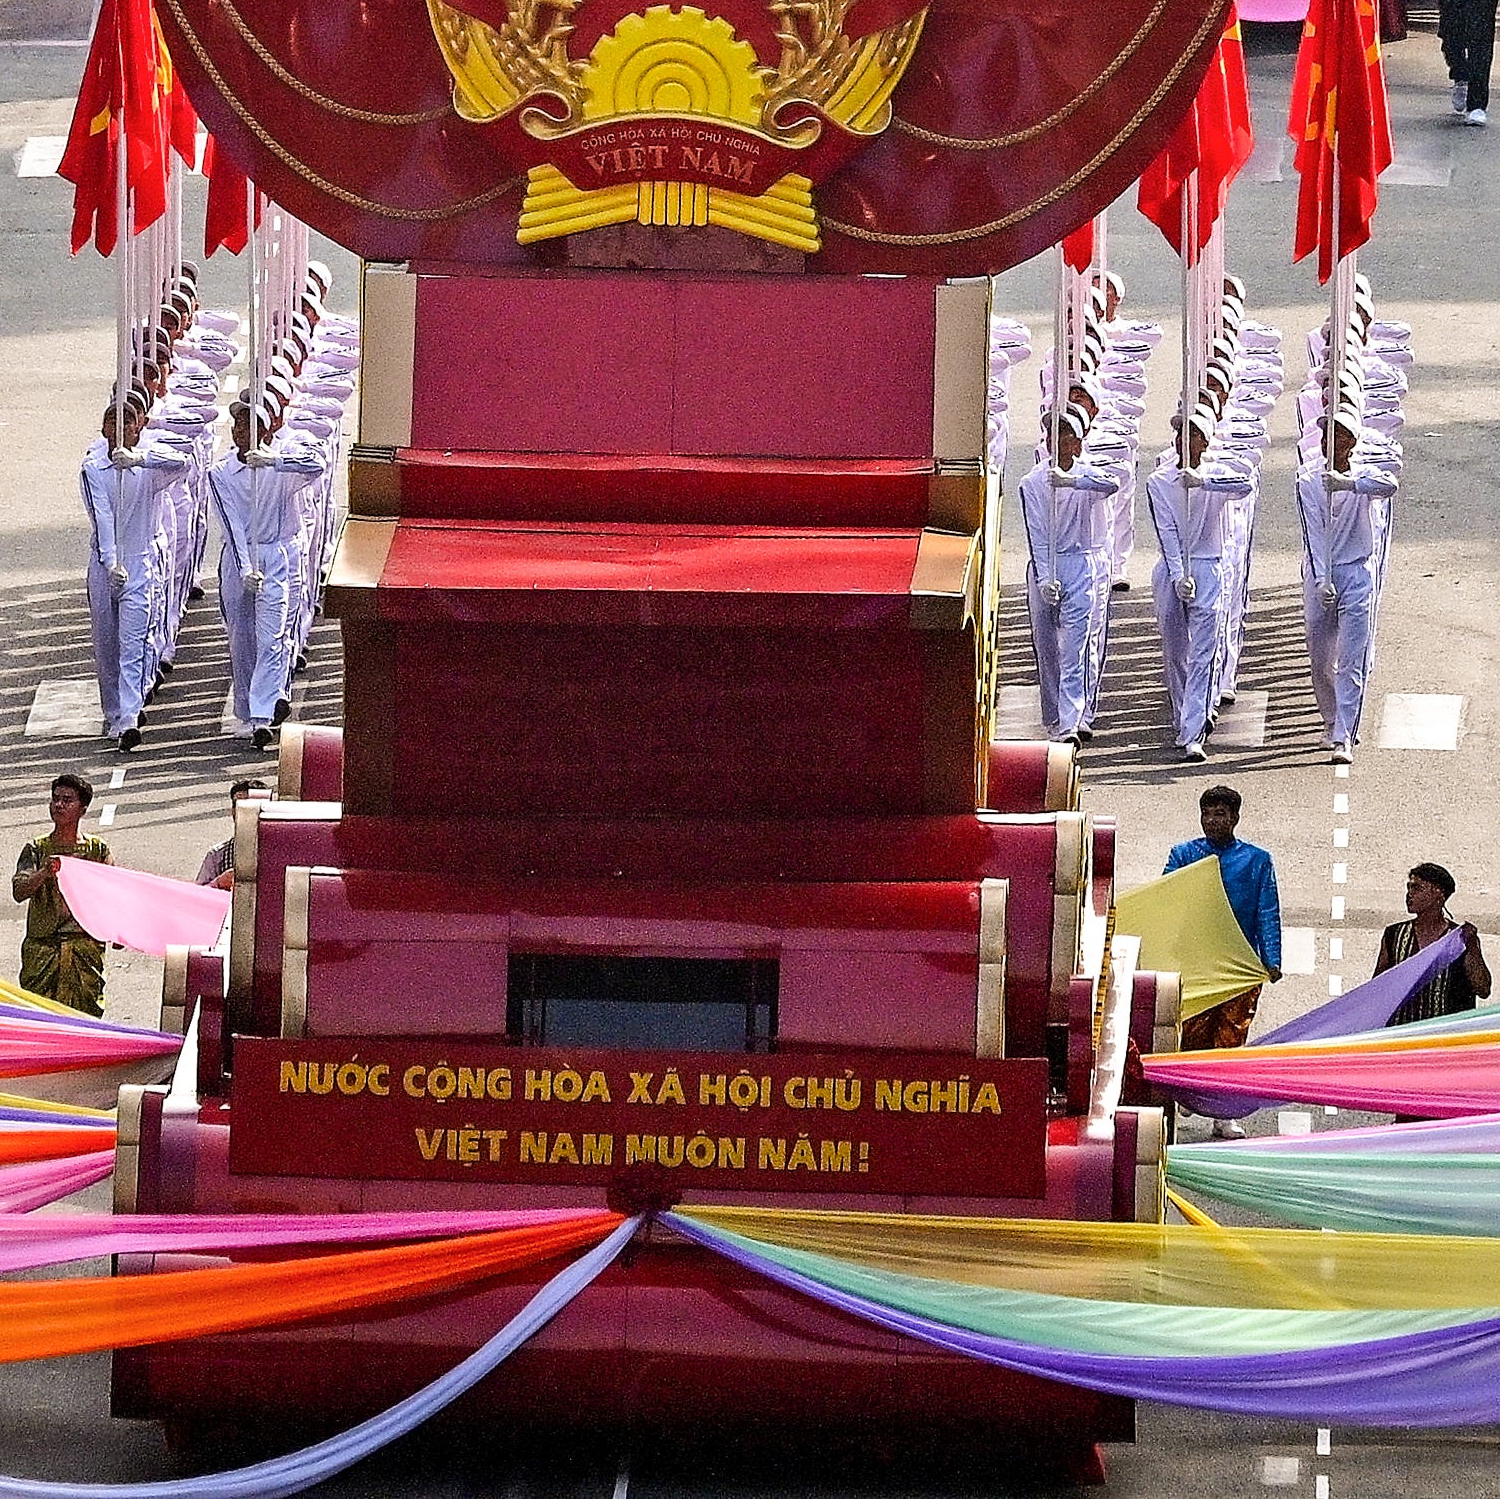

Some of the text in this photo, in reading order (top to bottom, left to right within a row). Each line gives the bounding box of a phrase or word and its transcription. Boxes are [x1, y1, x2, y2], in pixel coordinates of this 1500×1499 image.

[586, 141, 758, 184] VIỆT NAM
[280, 1053, 1002, 1115] NƯỚC CỘNG HÒA XÃ HỘI CHỦ NGHĨA
[415, 1123, 870, 1173] VIỆT NAM MUÔN NĂM!
